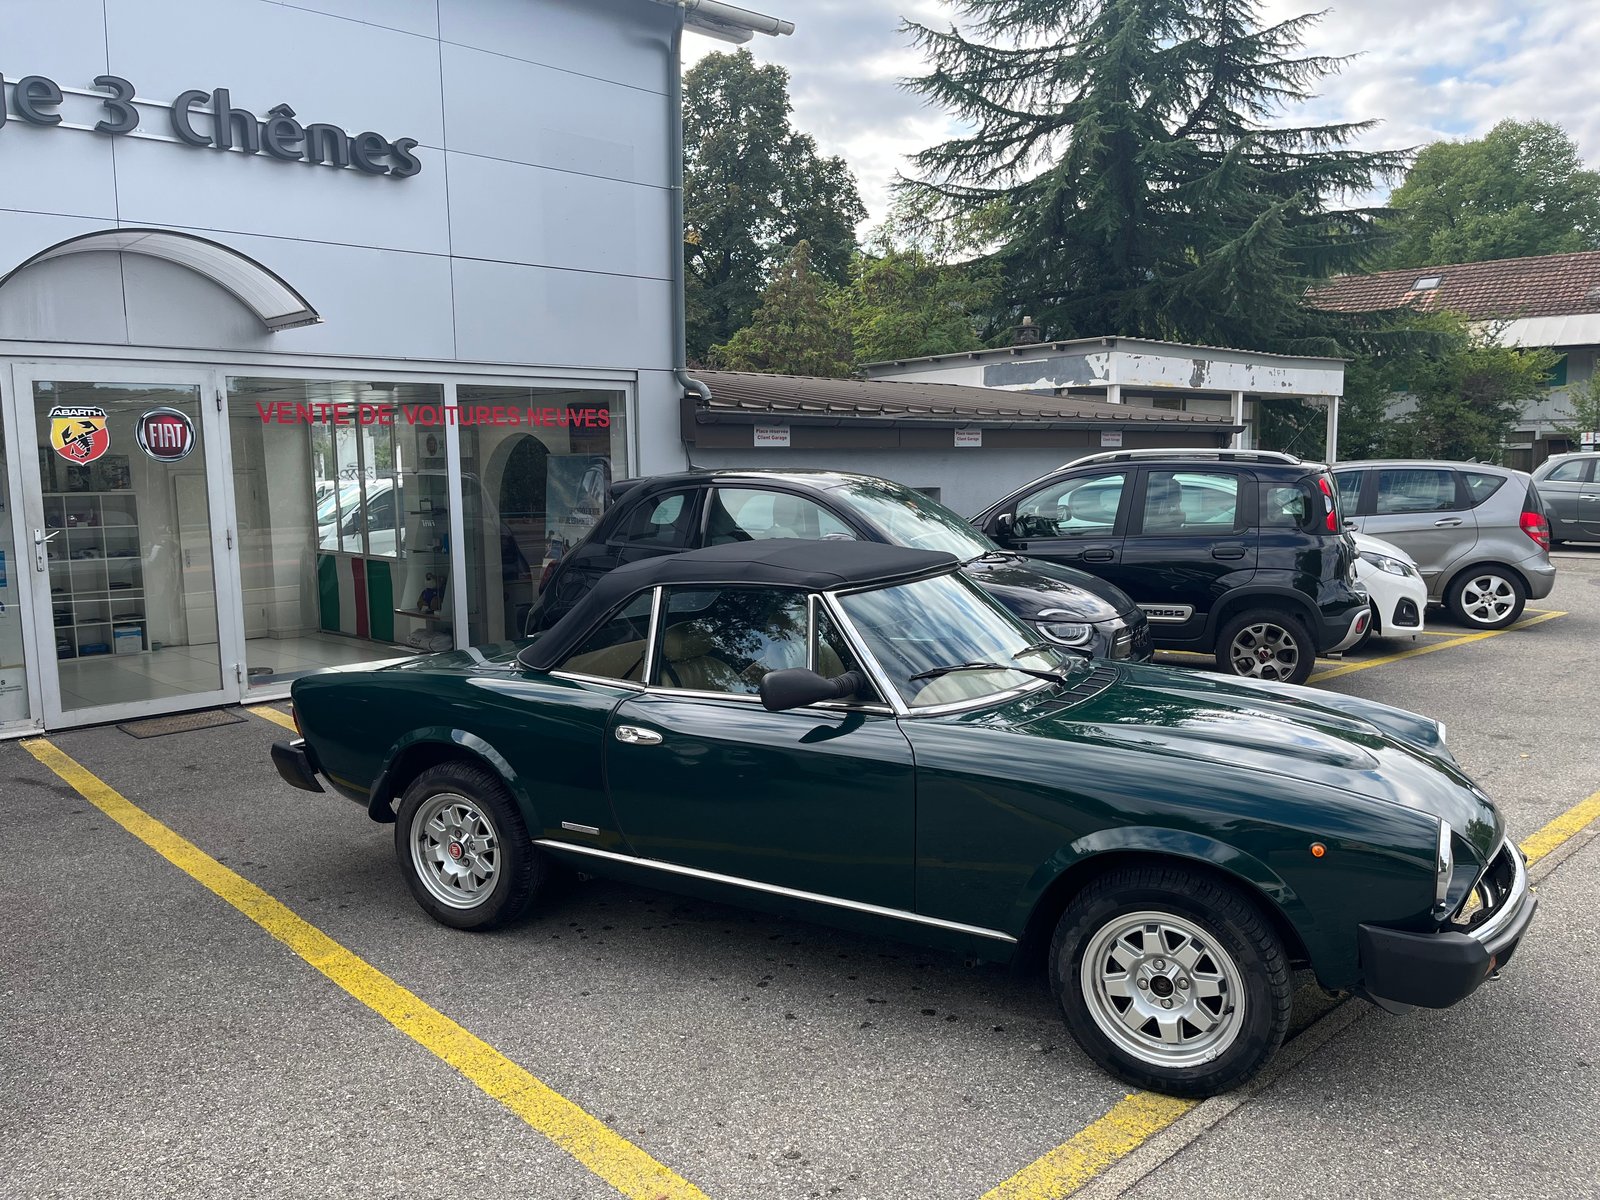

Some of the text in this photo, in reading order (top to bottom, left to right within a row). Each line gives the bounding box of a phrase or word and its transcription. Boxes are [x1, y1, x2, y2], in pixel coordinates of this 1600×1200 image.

[0, 71, 422, 179] e 3 Chênes
[53, 408, 102, 416] ABARTH
[255, 401, 611, 428] VENTE DE VOITURES NEUVES
[149, 423, 183, 448] FIAT
